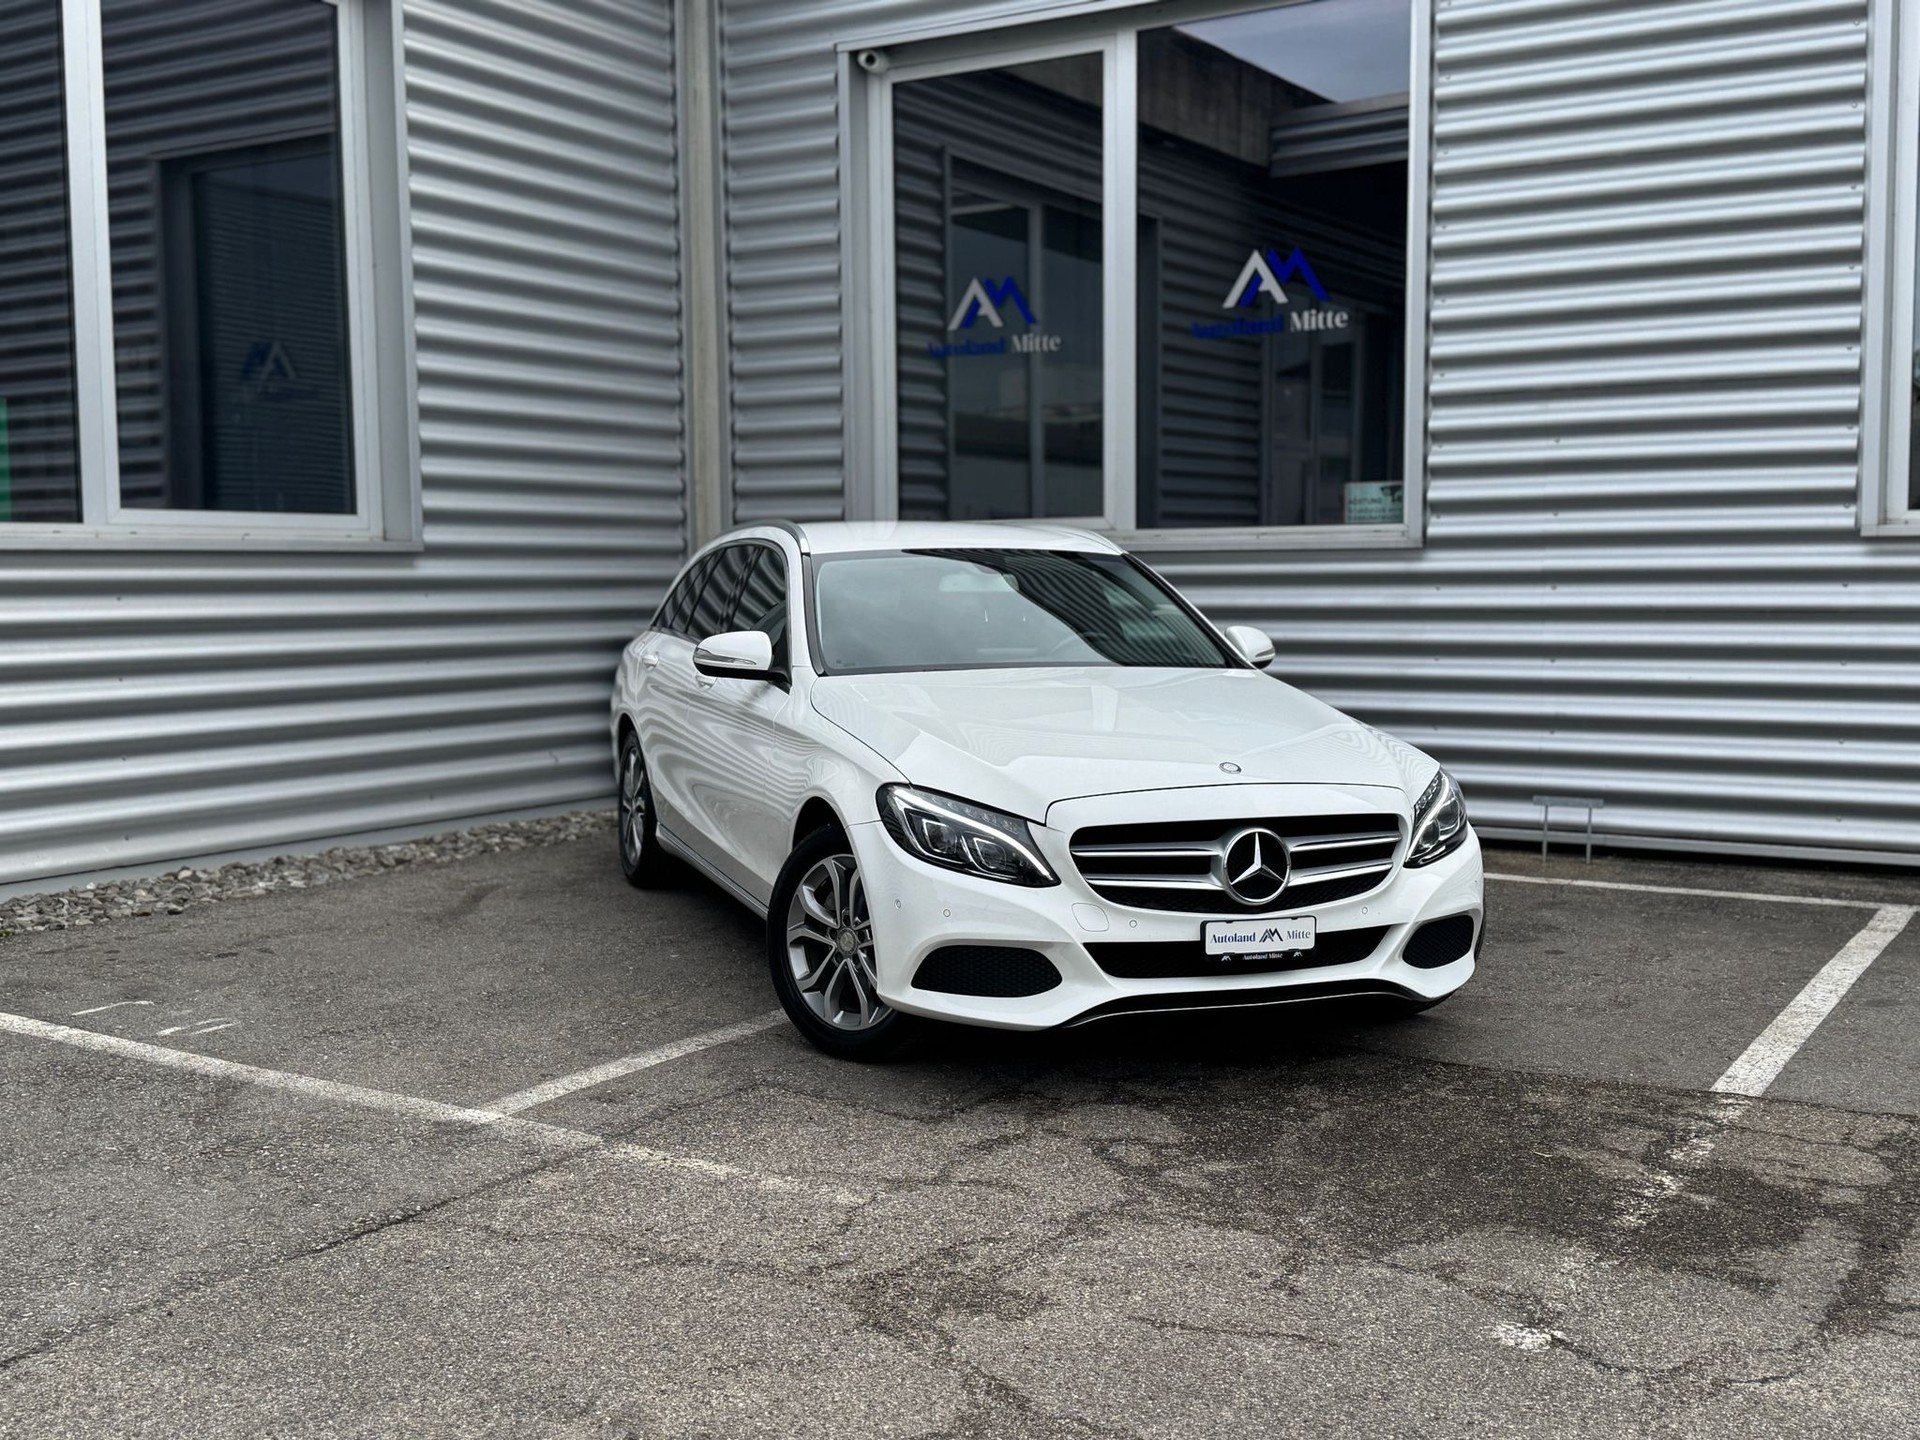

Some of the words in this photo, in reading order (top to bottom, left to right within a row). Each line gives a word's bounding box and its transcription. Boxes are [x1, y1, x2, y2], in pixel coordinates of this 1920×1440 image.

[1290, 309, 1348, 331] Mitte
[1011, 333, 1061, 353] Mitte
[1210, 932, 1256, 943] Autoland
[1286, 930, 1311, 939] Mitte
